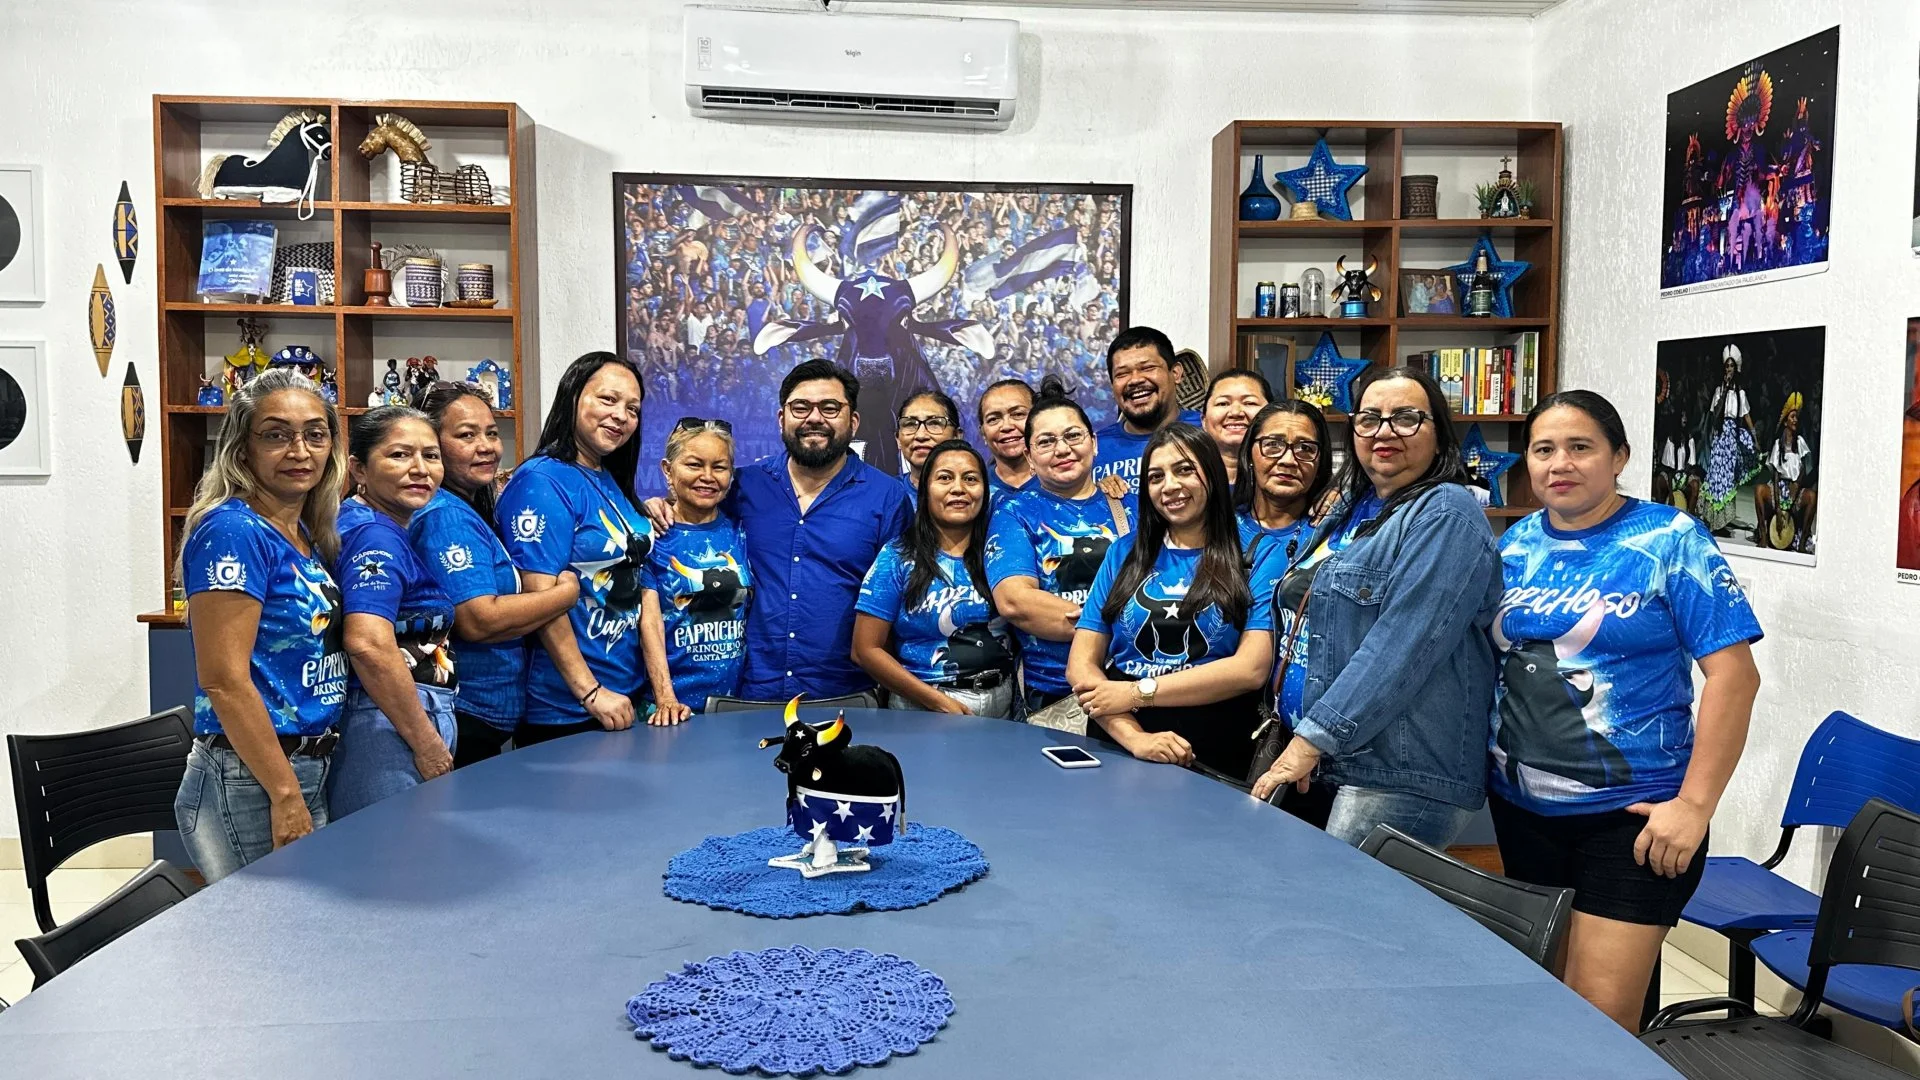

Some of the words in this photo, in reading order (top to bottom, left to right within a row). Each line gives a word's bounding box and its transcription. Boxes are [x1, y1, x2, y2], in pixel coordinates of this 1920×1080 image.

[522, 518, 532, 532] C
[451, 551, 462, 563] C
[221, 565, 234, 581] C
[1897, 572, 1918, 581] PEDRO
[692, 653, 721, 662] CANTA
